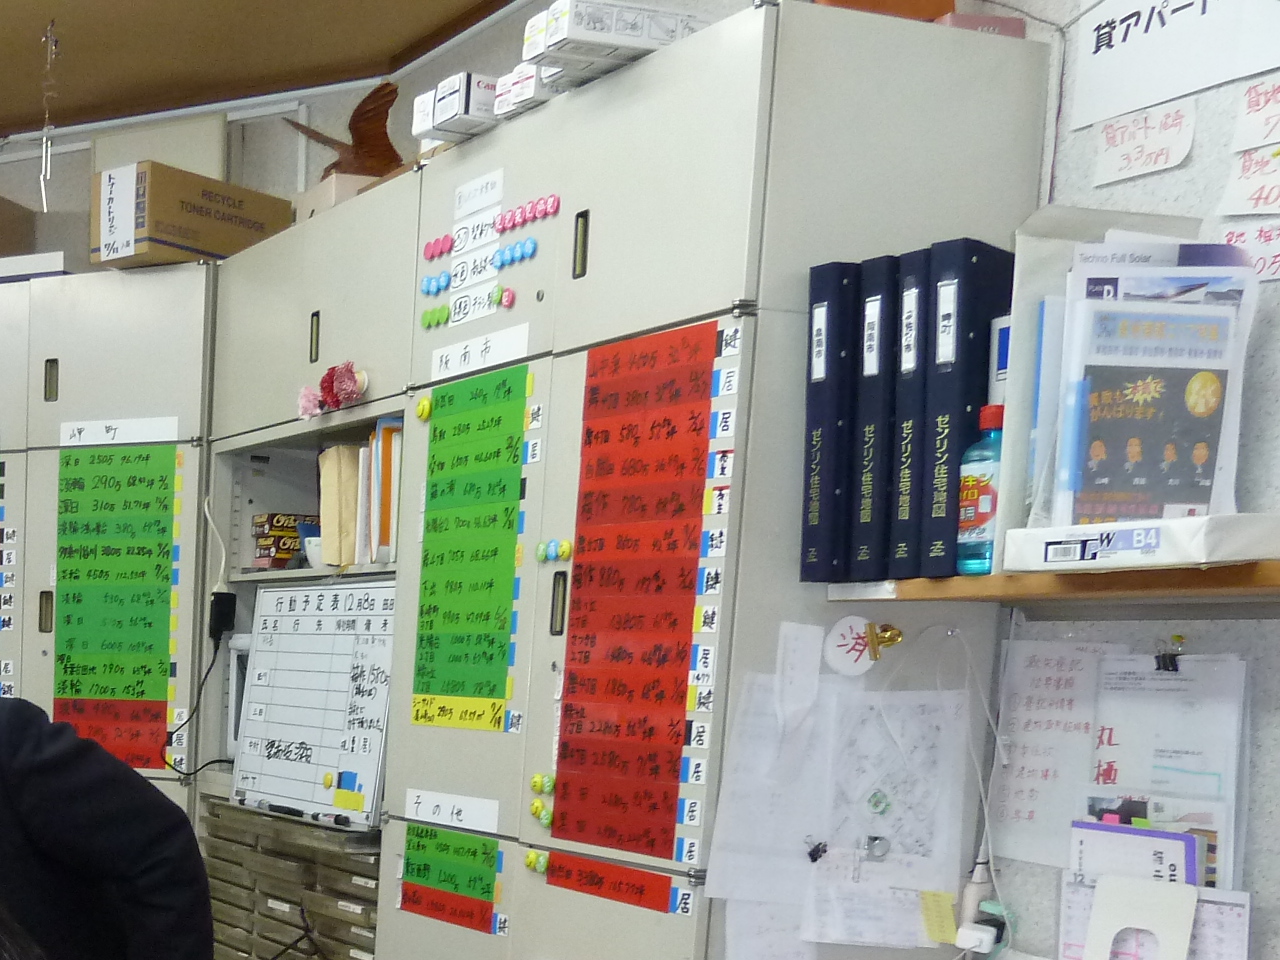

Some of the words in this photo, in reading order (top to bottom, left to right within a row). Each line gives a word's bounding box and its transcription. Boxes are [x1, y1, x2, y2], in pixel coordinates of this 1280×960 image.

[476, 79, 497, 92] Can
[201, 189, 245, 210] RECYCLE
[180, 200, 212, 218] TONER
[214, 208, 267, 232] CARTRIDGE
[1079, 253, 1108, 264] Techno
[1110, 253, 1125, 263] Full
[1128, 253, 1152, 263] Solar
[438, 338, 492, 373] 阪南市
[69, 425, 118, 441] 岬町
[808, 428, 822, 525] ゼンリン住宅地図
[859, 424, 875, 523] ゼンリン住宅地図
[898, 419, 913, 520] ゼンリン住宅地図
[932, 414, 950, 518] ゼンリン住宅地図
[1132, 529, 1158, 548] B4
[275, 592, 341, 613] 行動予定表
[344, 592, 376, 612] 12月8日
[261, 619, 278, 631] 氏名
[292, 618, 323, 632] 行先
[364, 618, 389, 632] 備考
[414, 795, 463, 822] その他
